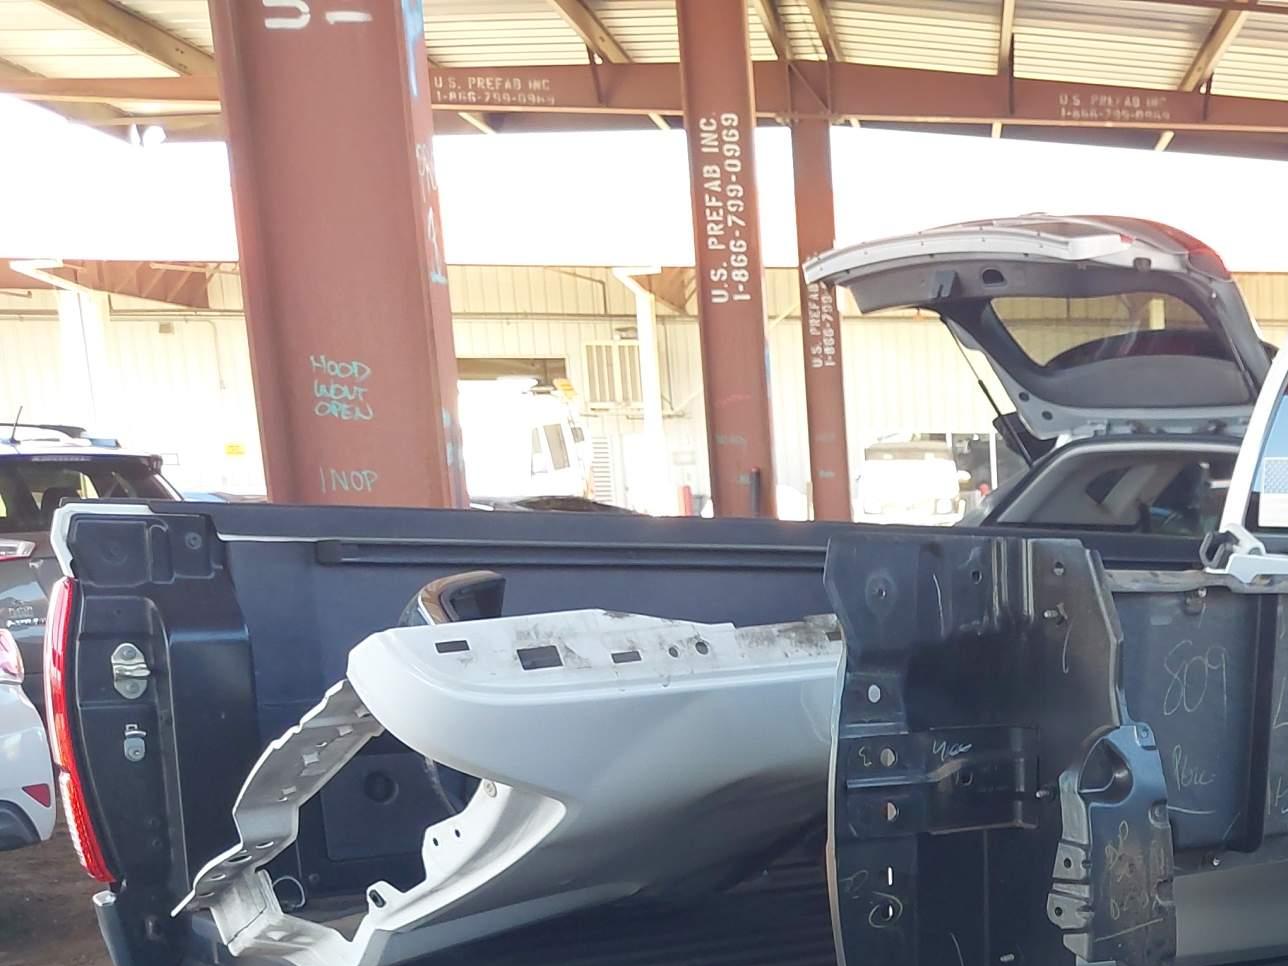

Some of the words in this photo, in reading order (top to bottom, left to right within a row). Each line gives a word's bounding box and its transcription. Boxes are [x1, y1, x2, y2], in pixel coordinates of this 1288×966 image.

[703, 164, 726, 250] PREFAB
[720, 112, 751, 301] 1-866-799-0969
[710, 261, 730, 304] U.S.
[309, 355, 372, 383] HOOD
[314, 401, 374, 420] OPEN
